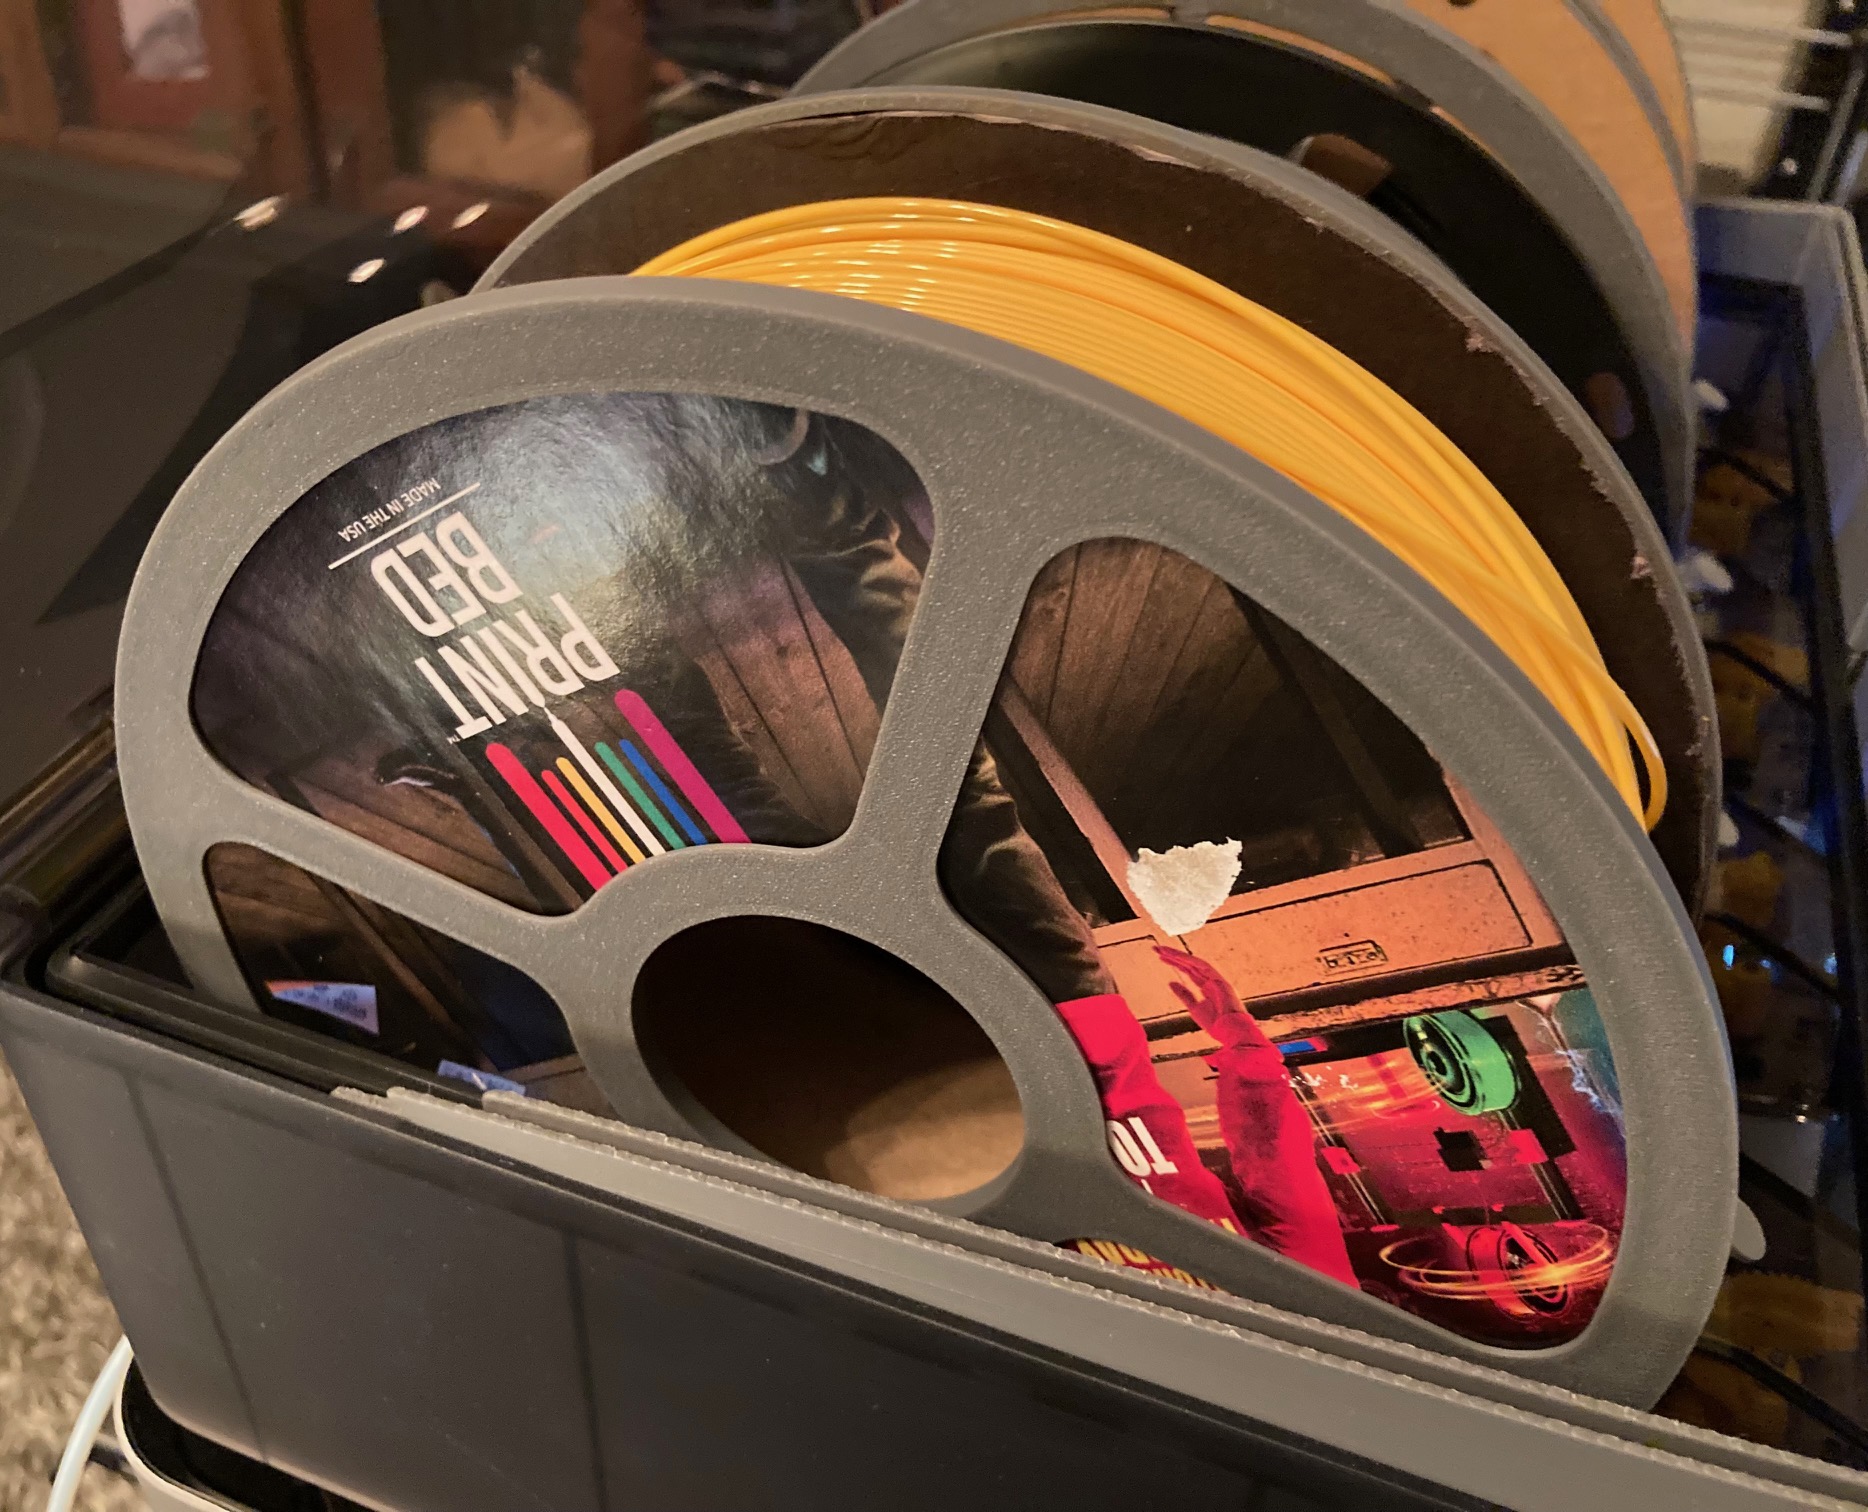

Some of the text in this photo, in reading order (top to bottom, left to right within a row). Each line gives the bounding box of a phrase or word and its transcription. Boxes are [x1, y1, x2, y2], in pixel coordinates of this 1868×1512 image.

[337, 477, 441, 542] MADE IN THE USA
[371, 511, 523, 637] BED
[415, 592, 621, 740] PRINT
